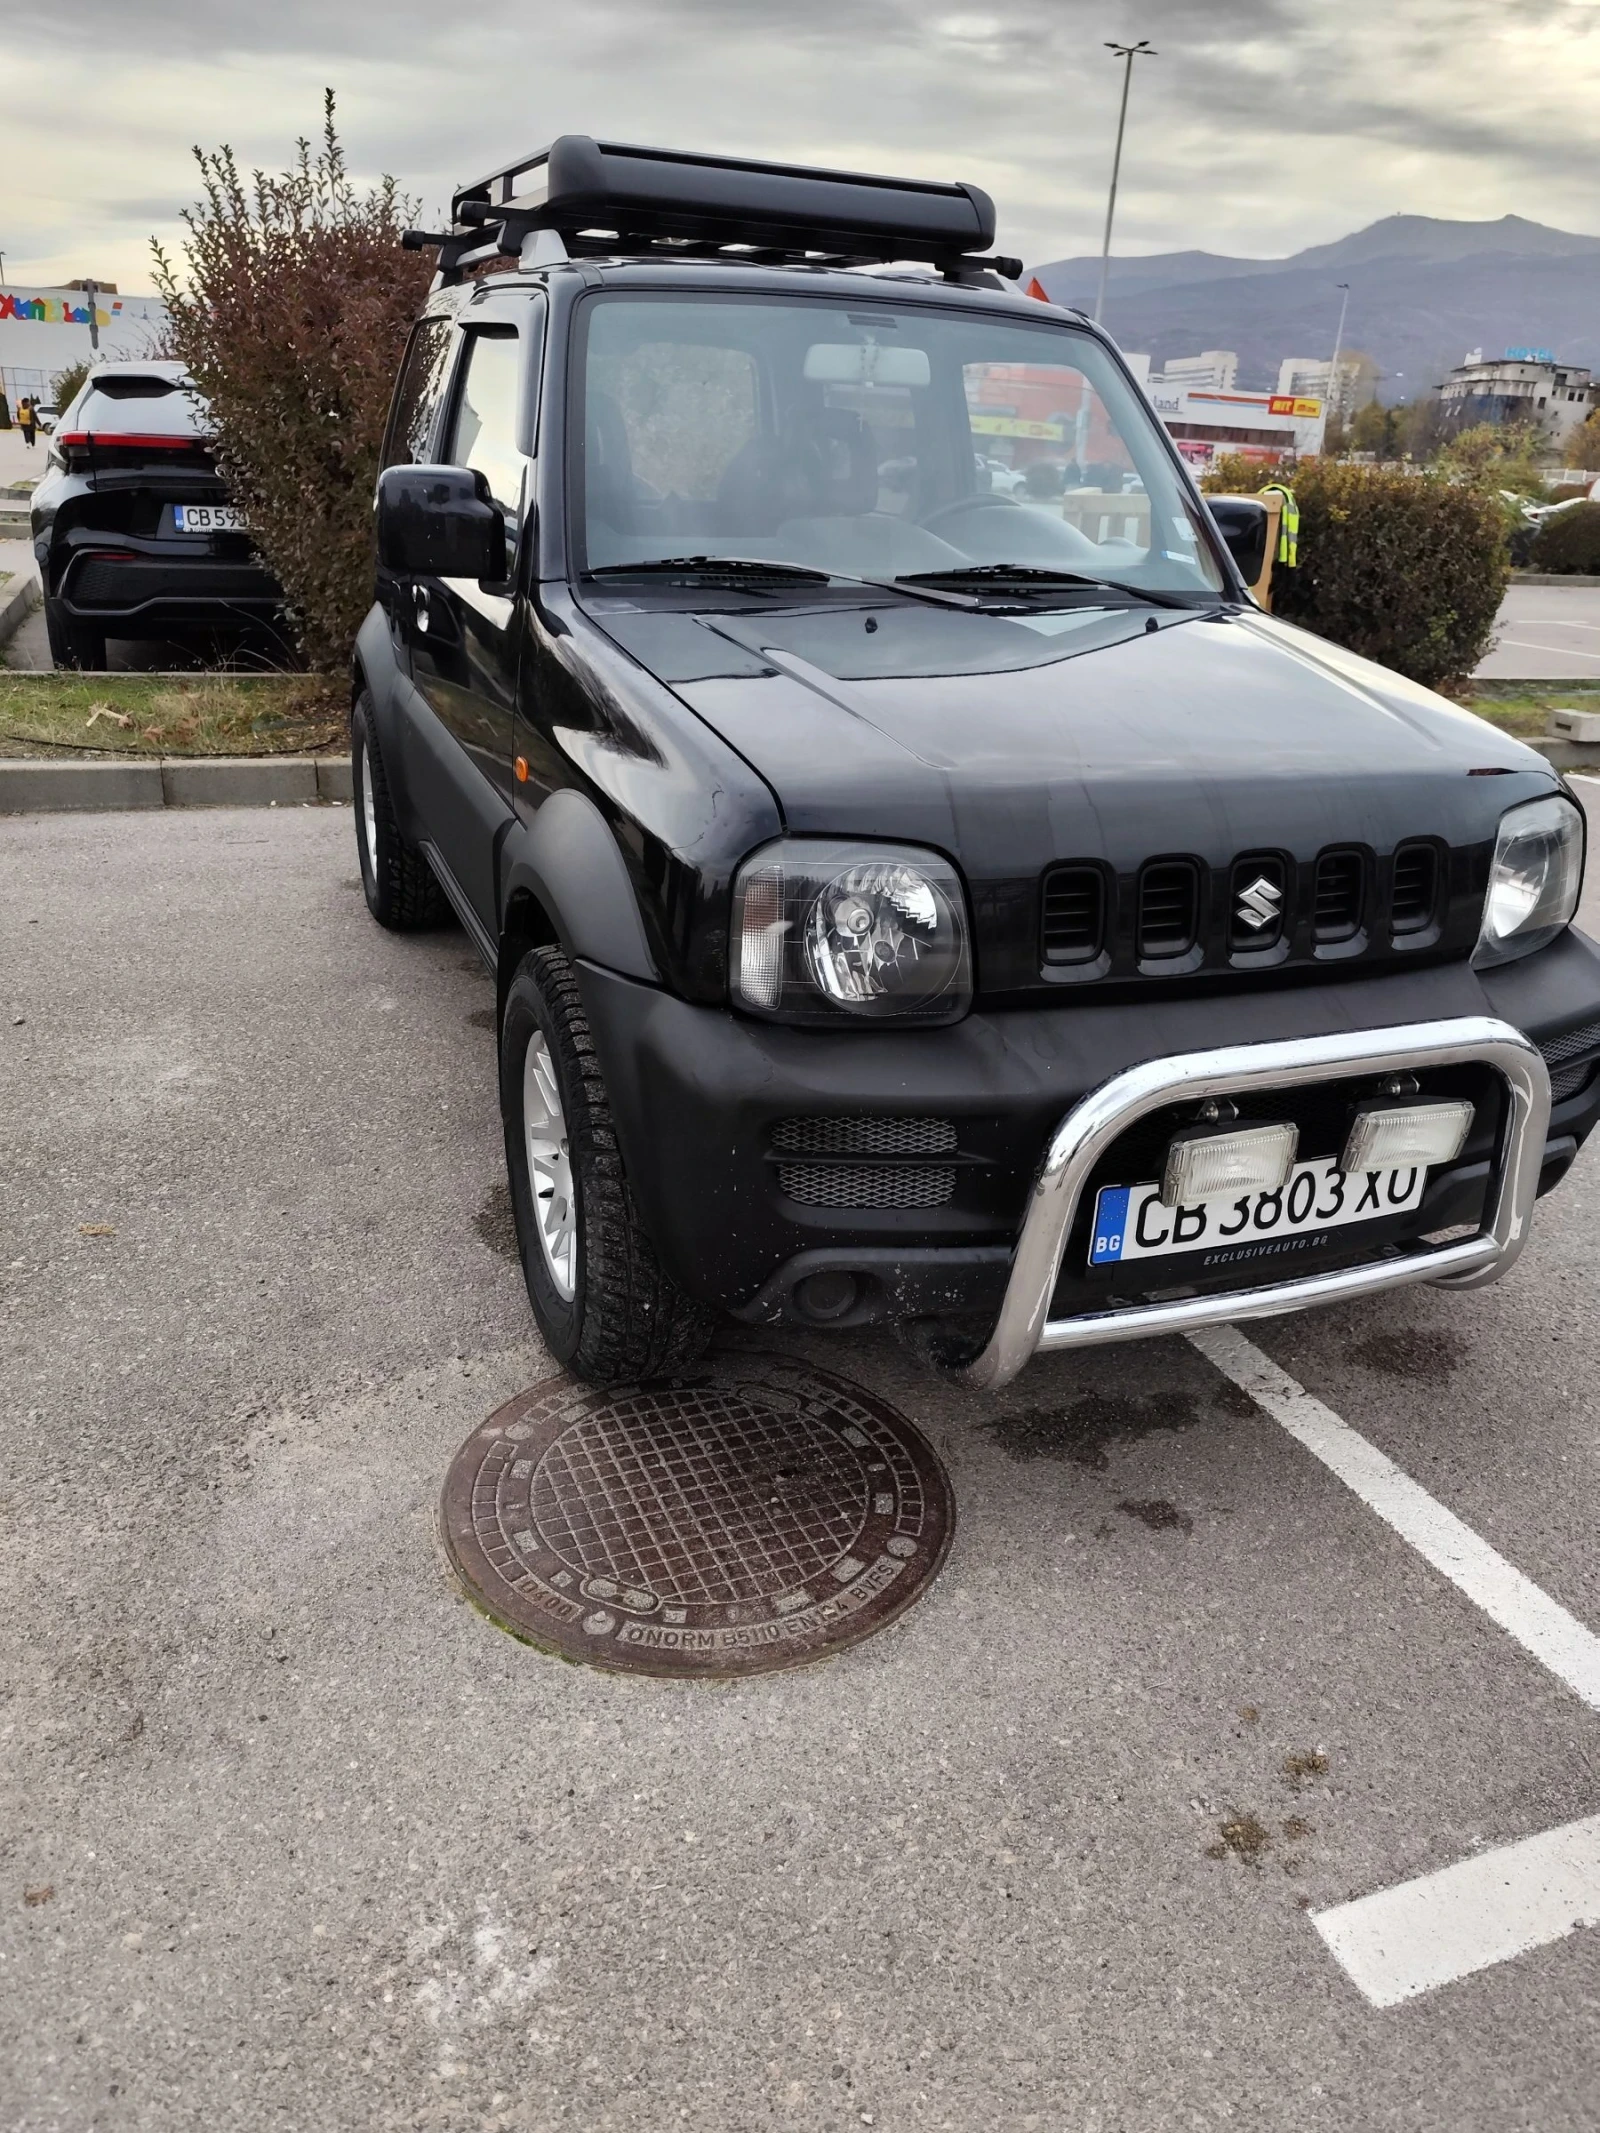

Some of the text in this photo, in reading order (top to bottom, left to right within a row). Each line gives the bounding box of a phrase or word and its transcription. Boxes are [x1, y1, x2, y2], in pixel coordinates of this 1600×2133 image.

[186, 508, 211, 527] CB
[1095, 1234, 1121, 1254] BG
[1135, 1192, 1207, 1248] CB
[1218, 1166, 1347, 1236] 3803
[1202, 1235, 1329, 1266] EXCLUSIVEAUTO.BG
